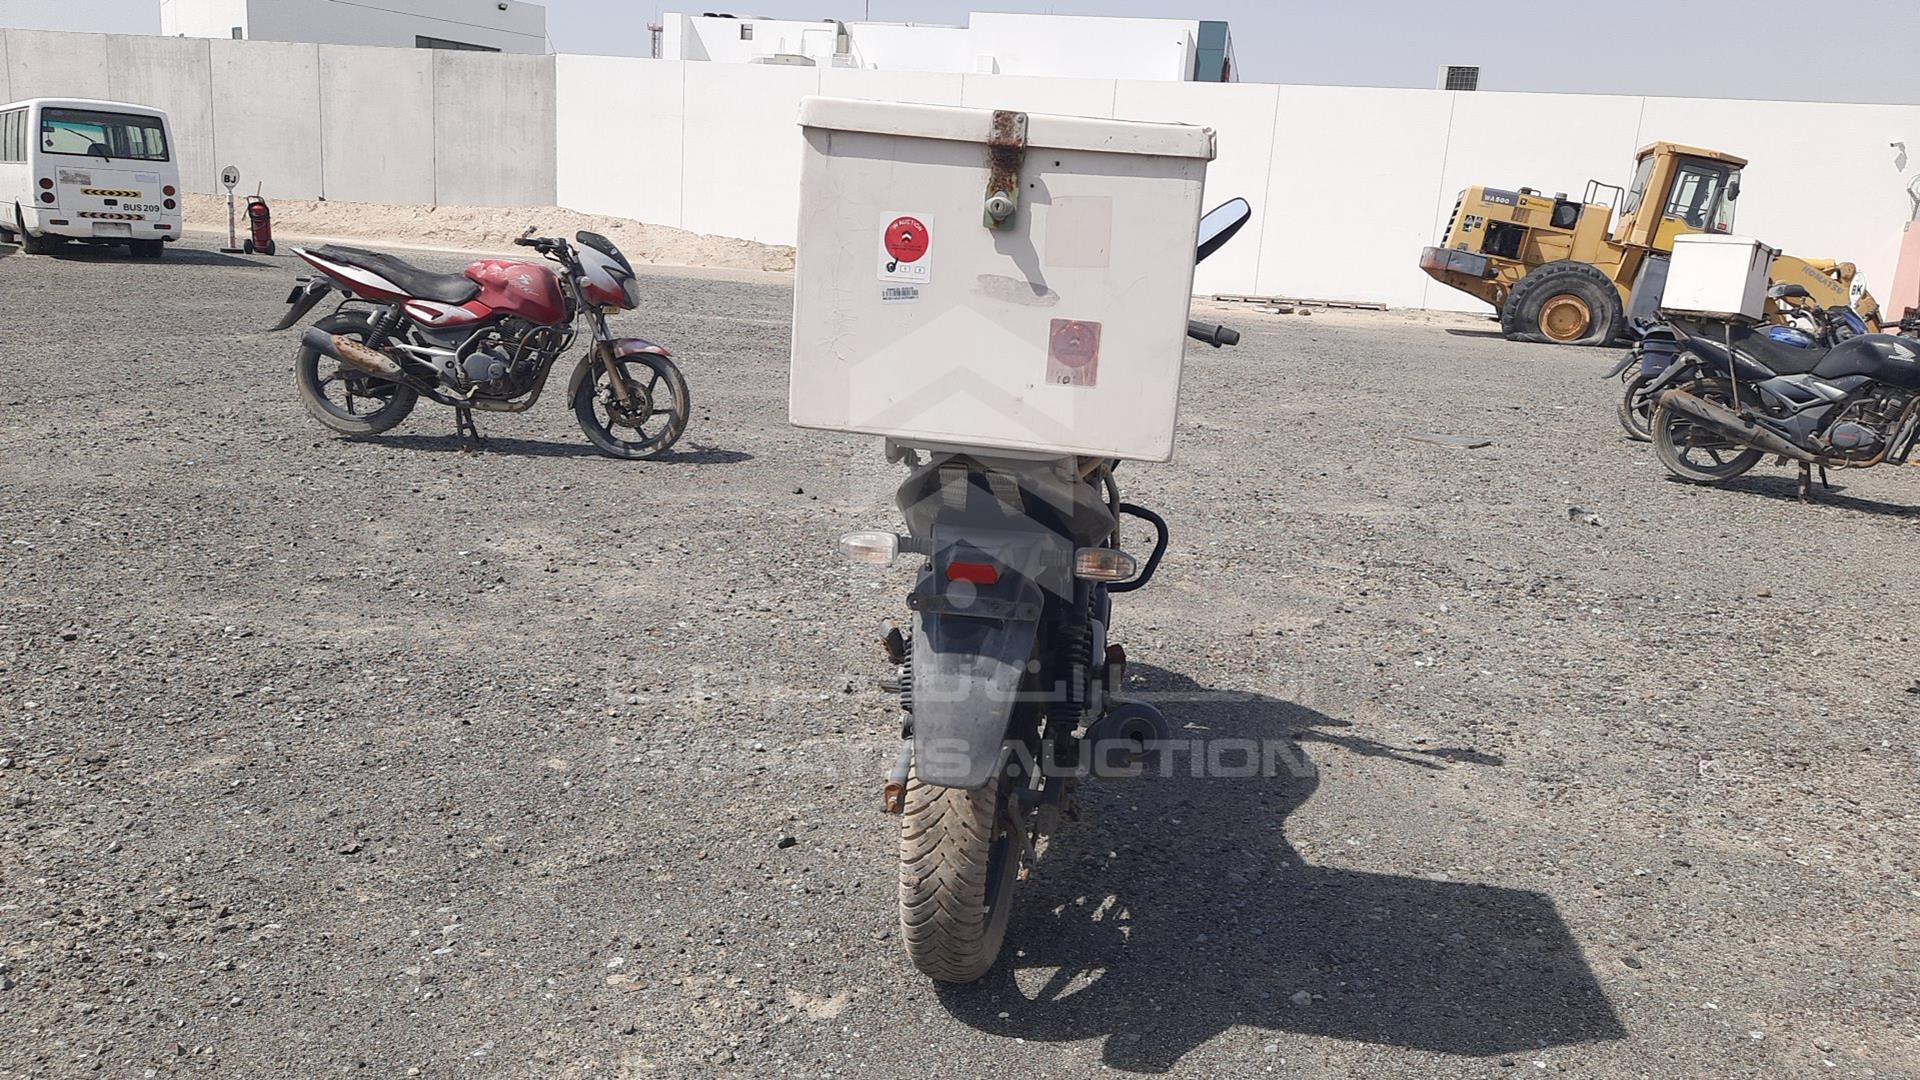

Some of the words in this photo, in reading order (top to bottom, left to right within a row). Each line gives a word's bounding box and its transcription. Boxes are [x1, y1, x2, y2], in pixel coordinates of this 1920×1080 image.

[224, 174, 236, 183] BJ
[123, 203, 142, 211] BUS
[143, 204, 160, 212] 209
[1851, 284, 1863, 295] BK
